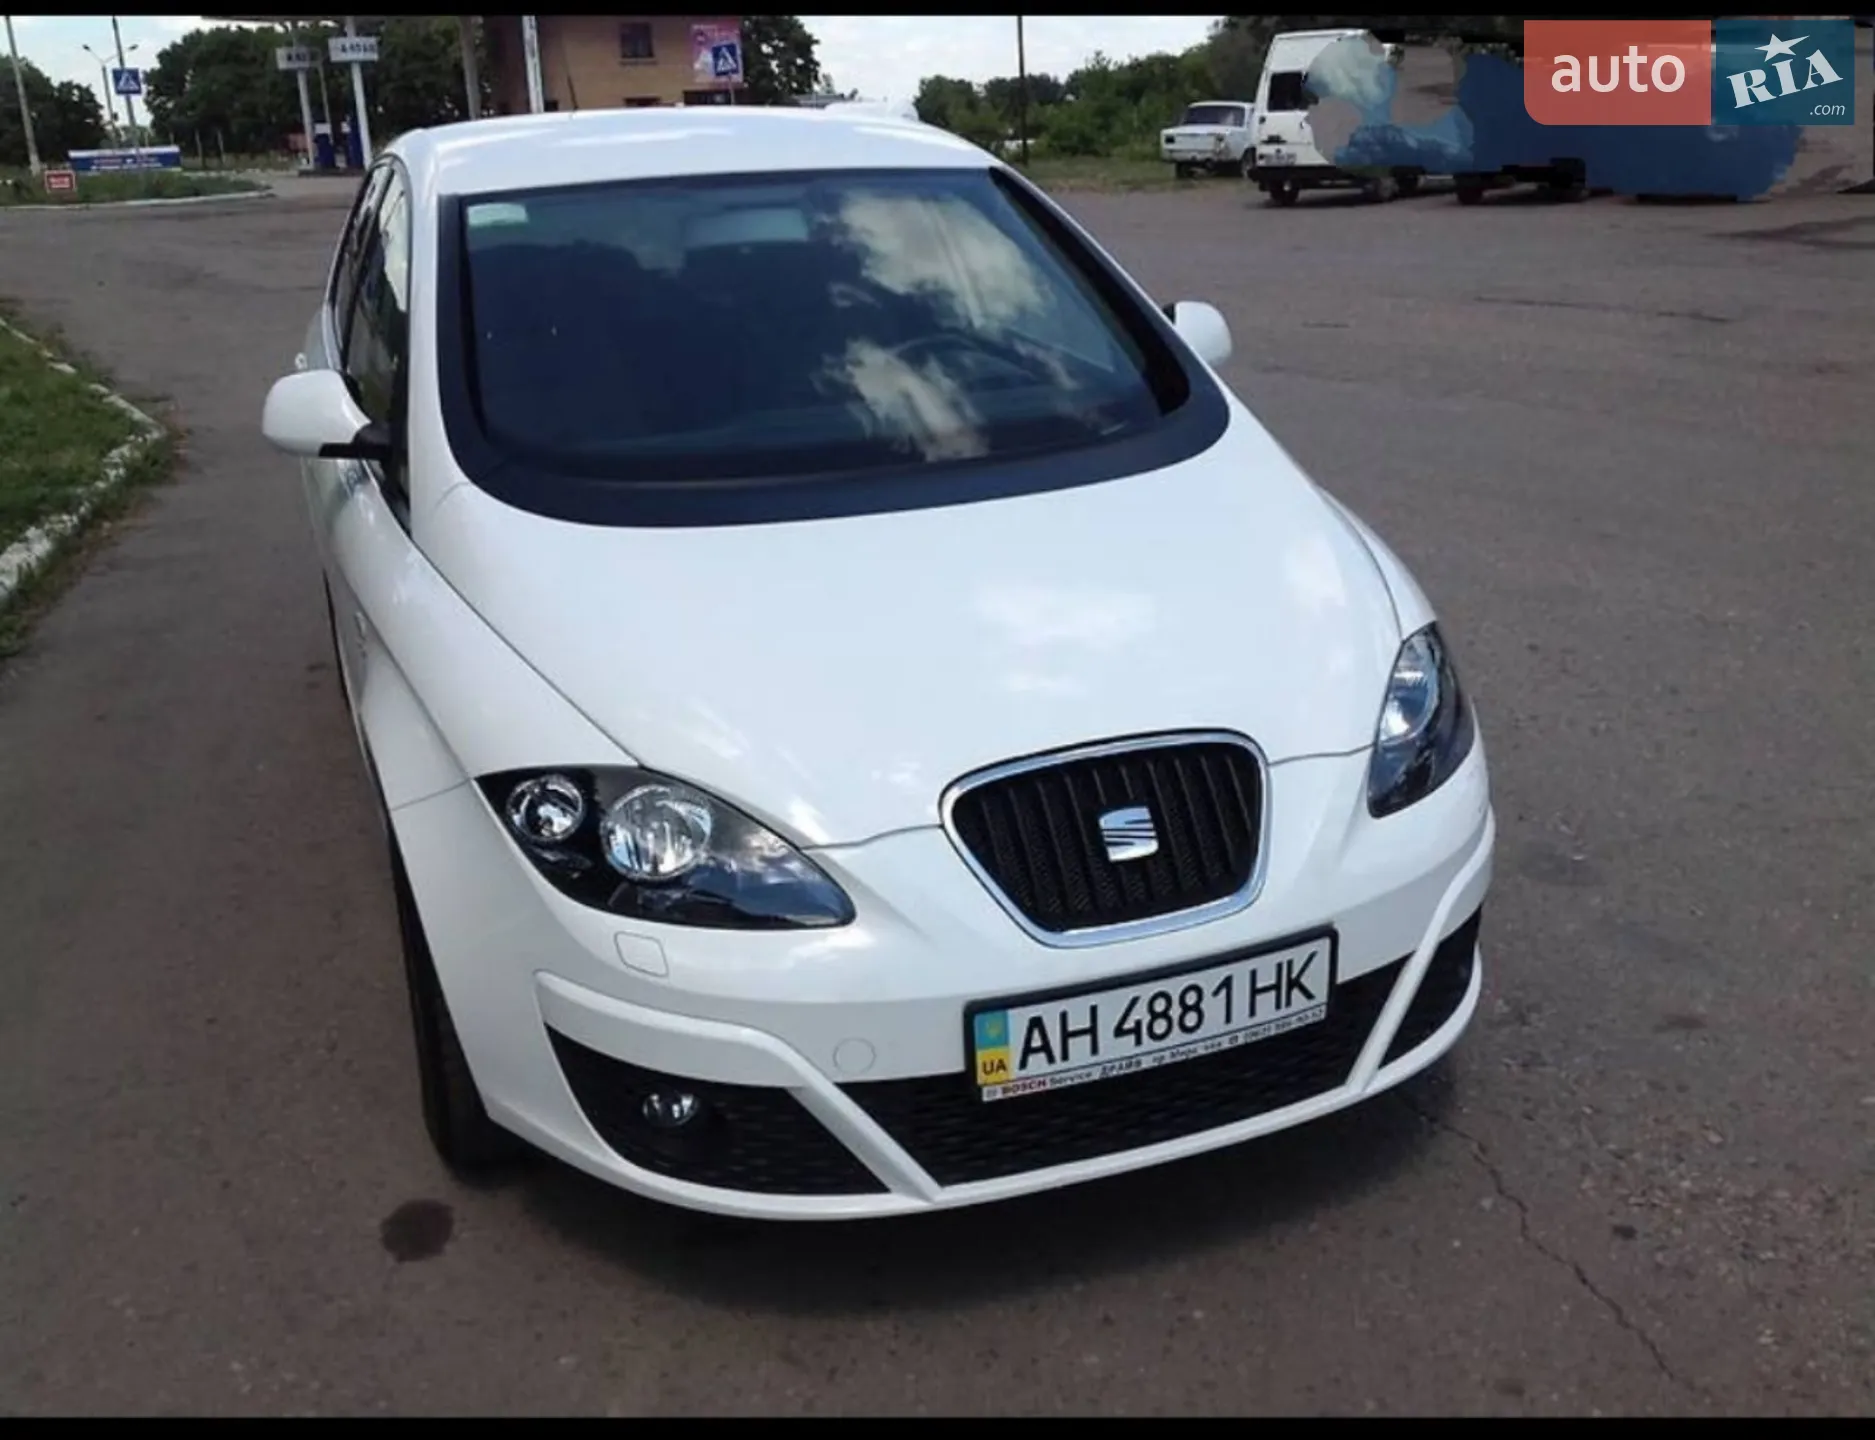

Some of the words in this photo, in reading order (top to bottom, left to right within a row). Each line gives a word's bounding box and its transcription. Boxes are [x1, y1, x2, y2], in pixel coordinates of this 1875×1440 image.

[1018, 1004, 1100, 1072] AH
[1113, 974, 1233, 1047] 4881
[1249, 950, 1318, 1019] HK
[982, 1060, 1008, 1077] UA
[1002, 1078, 1047, 1094] BOSCH
